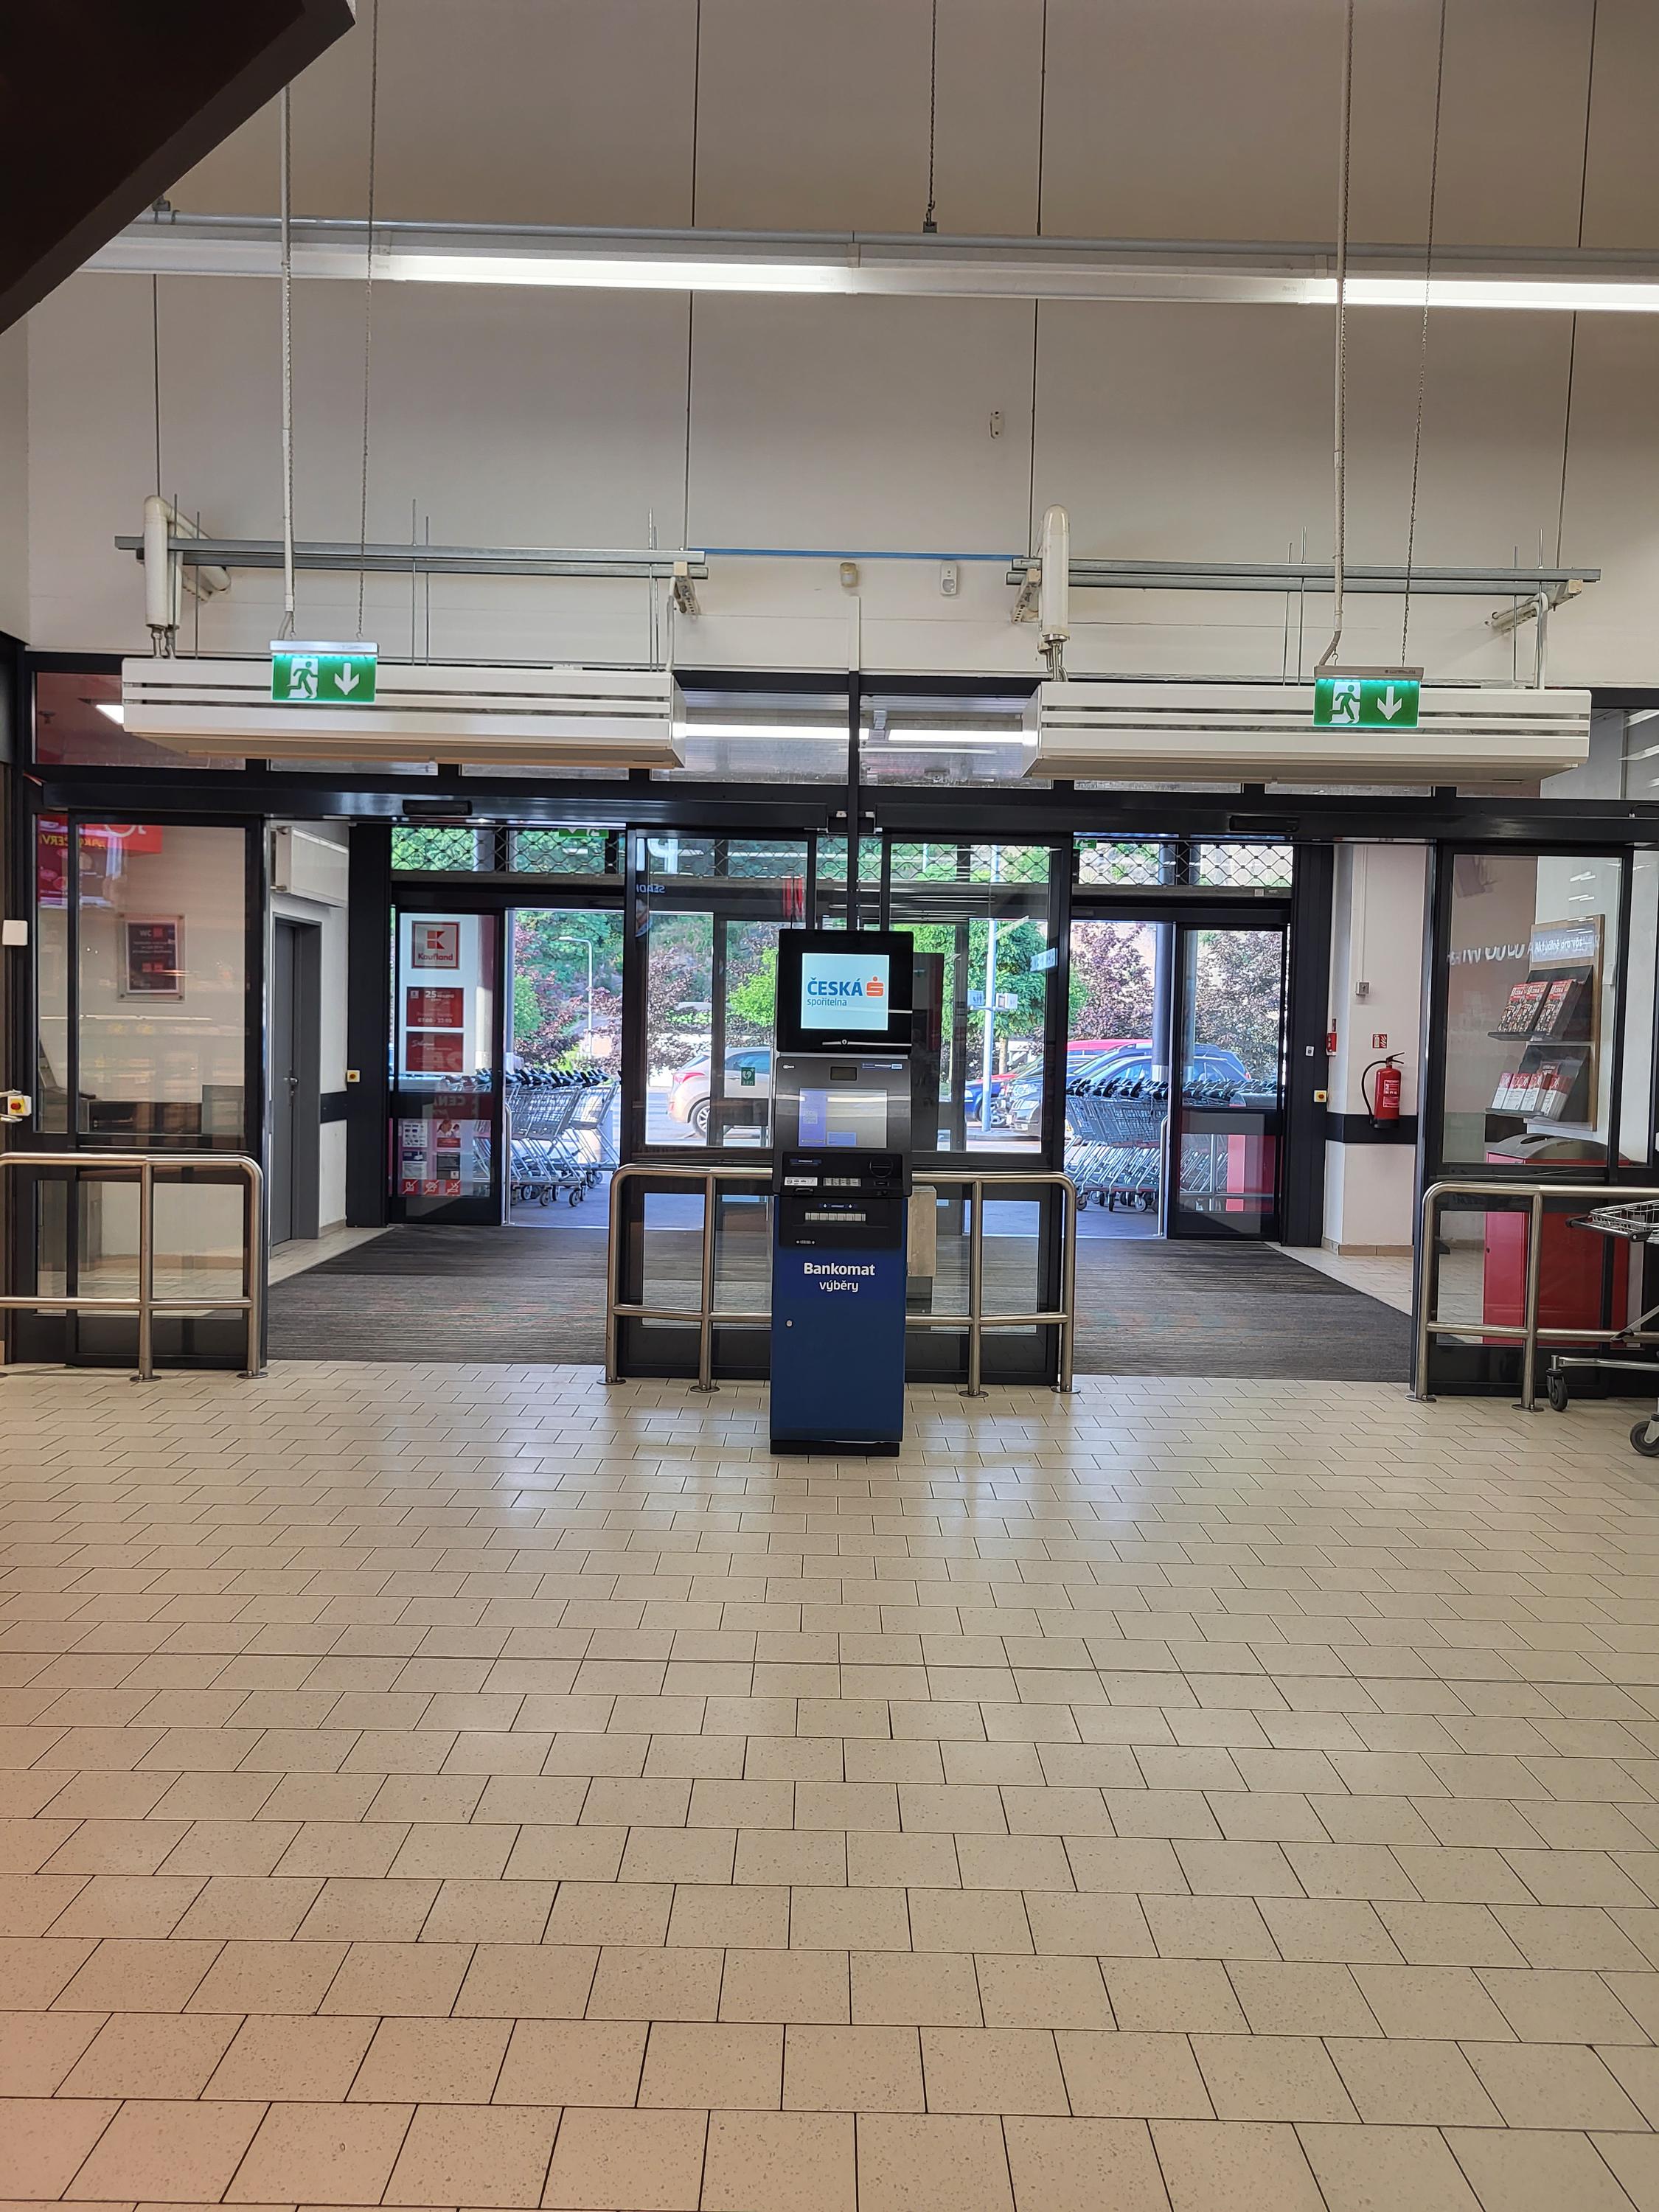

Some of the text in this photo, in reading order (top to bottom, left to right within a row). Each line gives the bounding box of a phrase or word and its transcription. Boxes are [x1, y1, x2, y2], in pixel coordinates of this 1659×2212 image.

[417, 953, 453, 961] Kaufland
[807, 977, 863, 996] ČESKÁ
[425, 990, 437, 998] 25
[807, 998, 847, 1007] spořitelna
[804, 1262, 876, 1276] Bankomat
[819, 1280, 859, 1293] výběry
